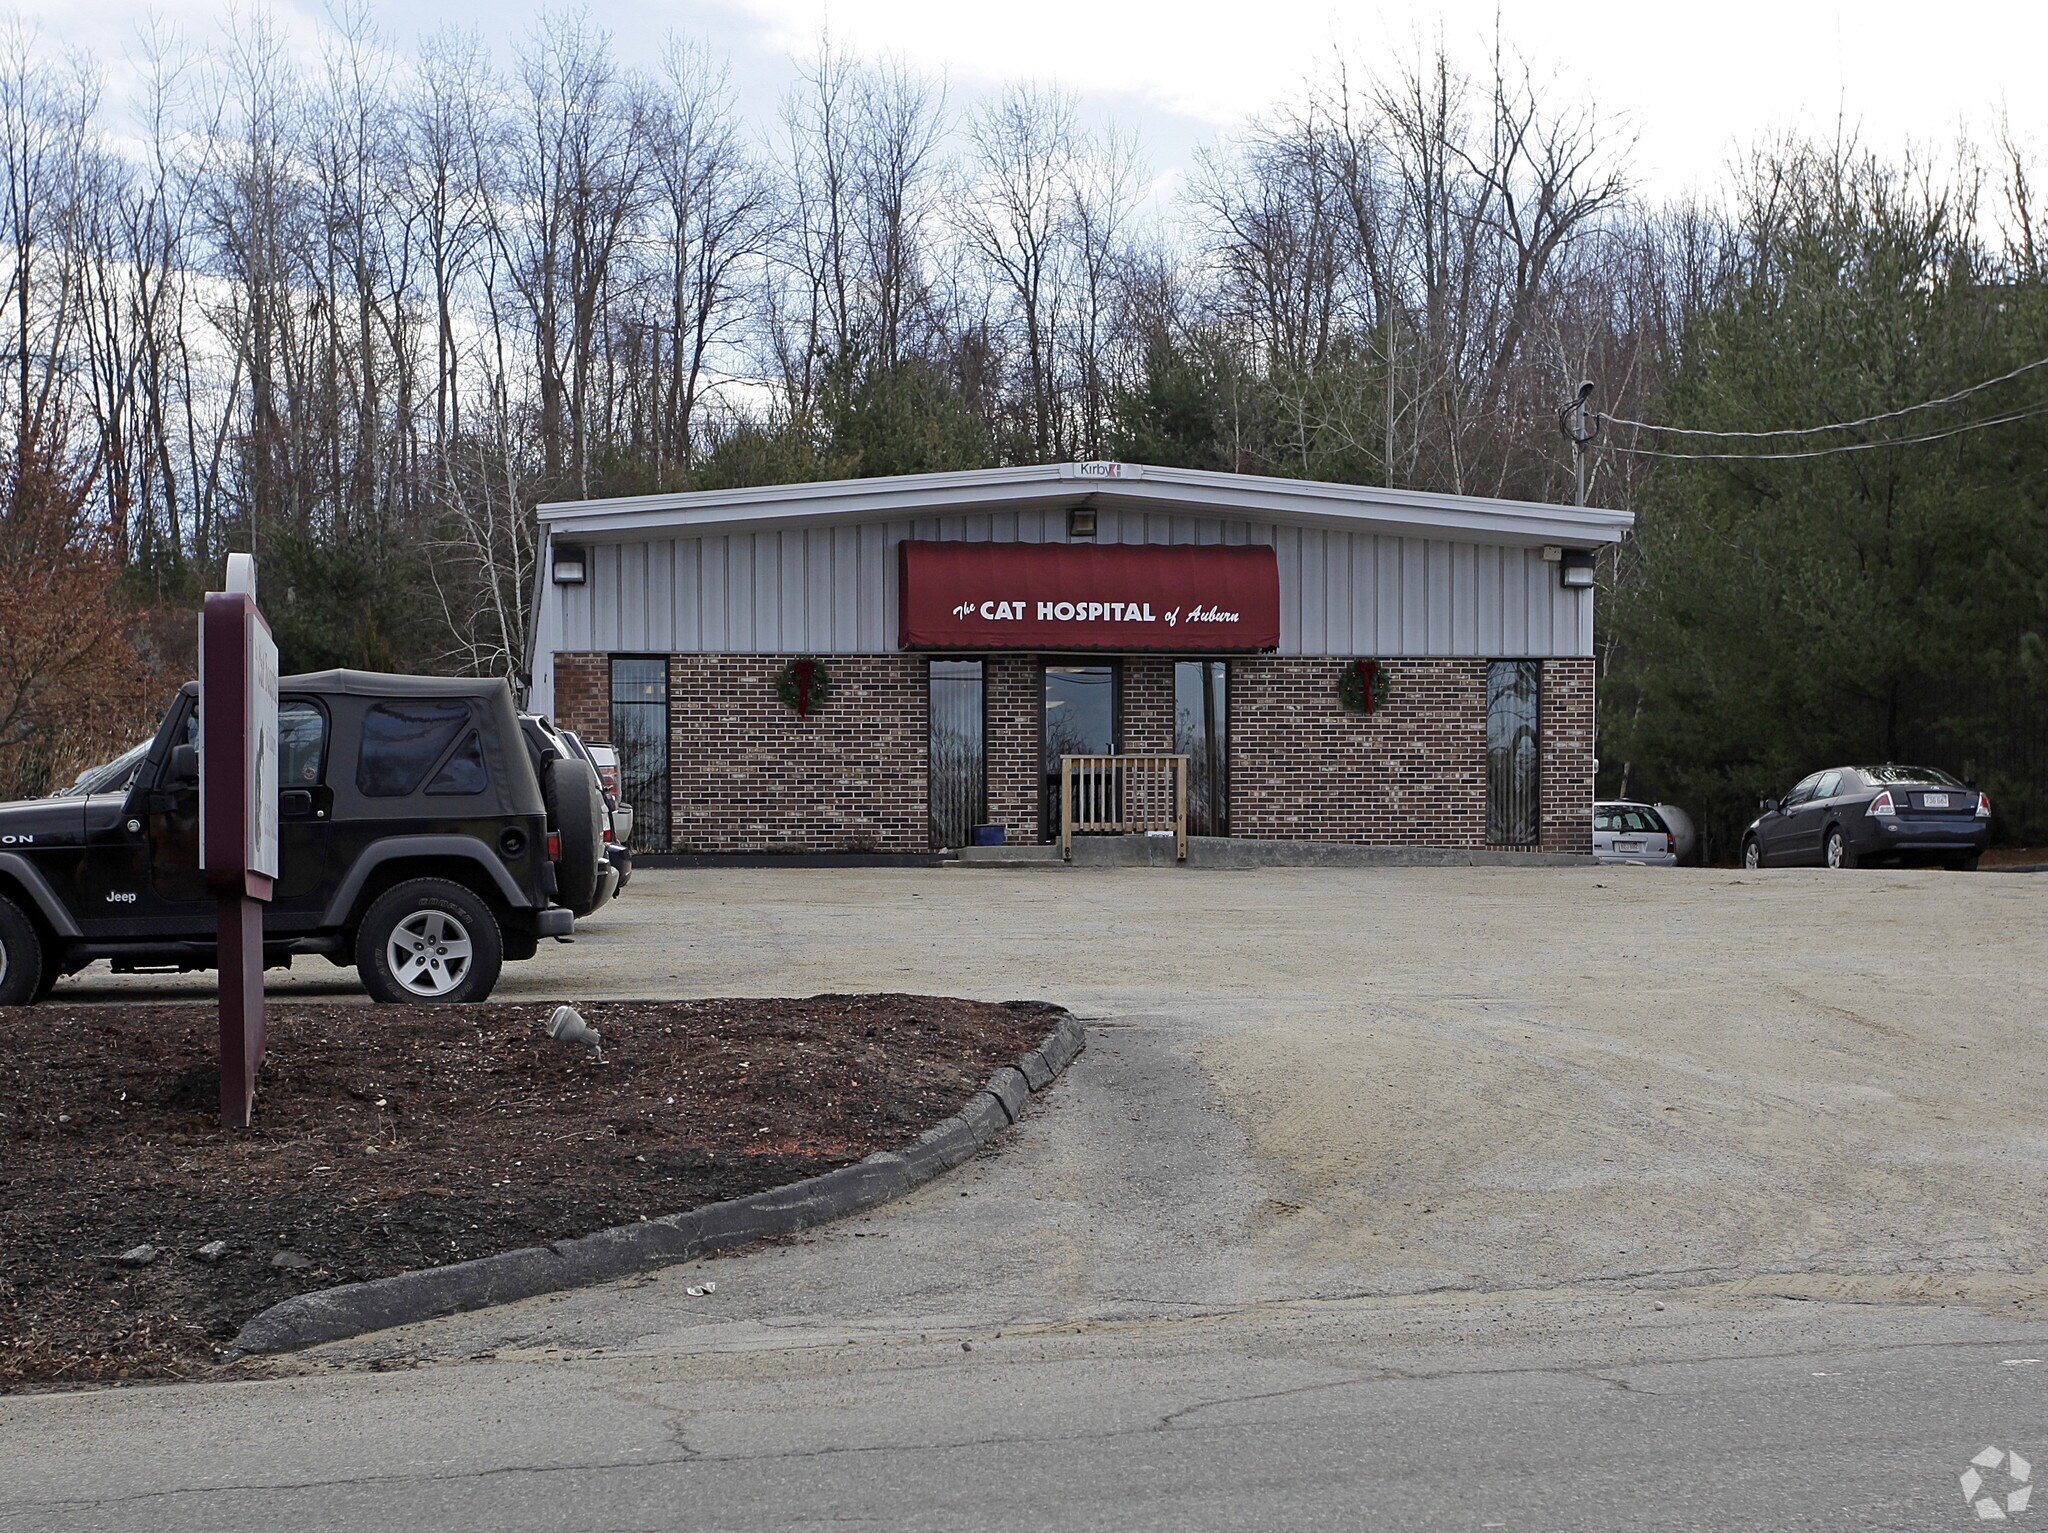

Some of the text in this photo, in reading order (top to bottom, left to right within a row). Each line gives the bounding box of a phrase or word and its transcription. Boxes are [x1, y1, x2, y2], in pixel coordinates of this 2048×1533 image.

[1080, 463, 1112, 477] Kirby
[952, 601, 1240, 627] The CAT HOSPITAL of Auburn
[106, 891, 137, 904] Jeep
